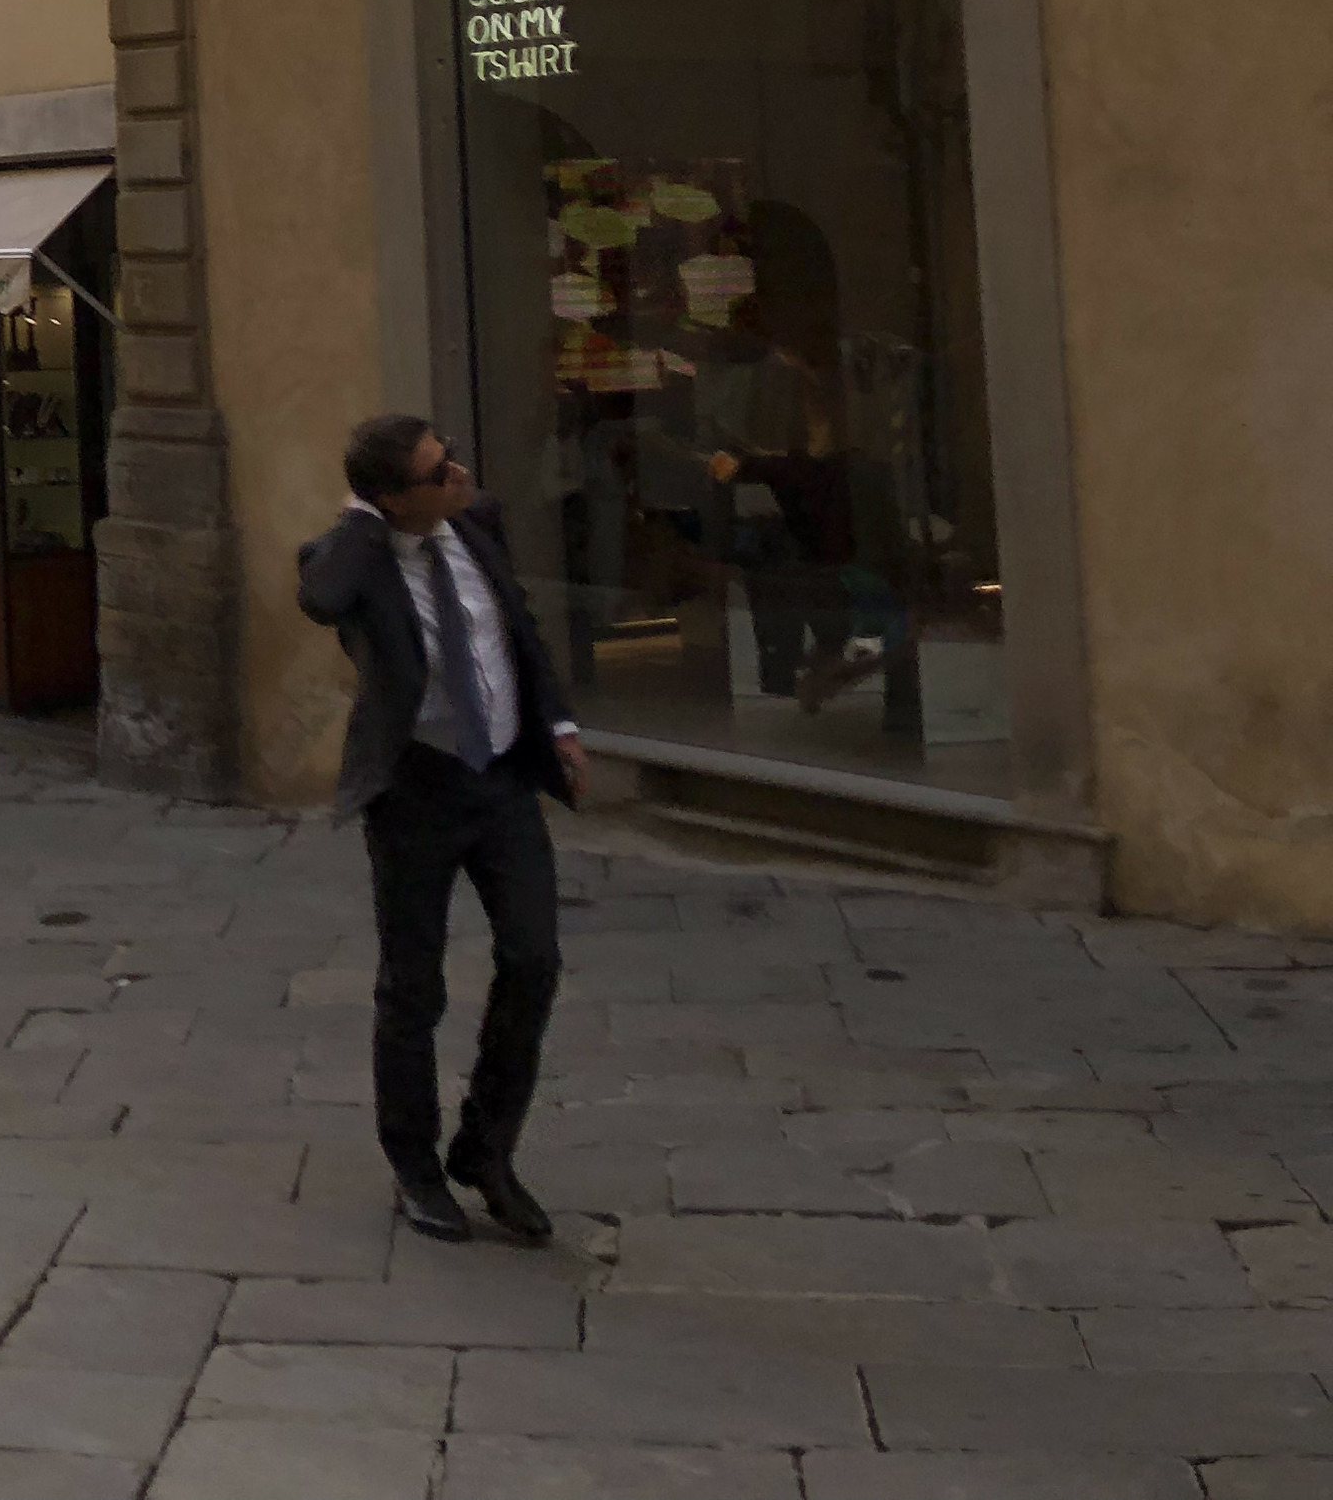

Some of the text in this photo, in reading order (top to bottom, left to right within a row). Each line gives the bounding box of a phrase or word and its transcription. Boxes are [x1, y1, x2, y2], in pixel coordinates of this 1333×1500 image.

[466, 5, 566, 44] ON MY
[470, 41, 578, 81] TSHIRT
